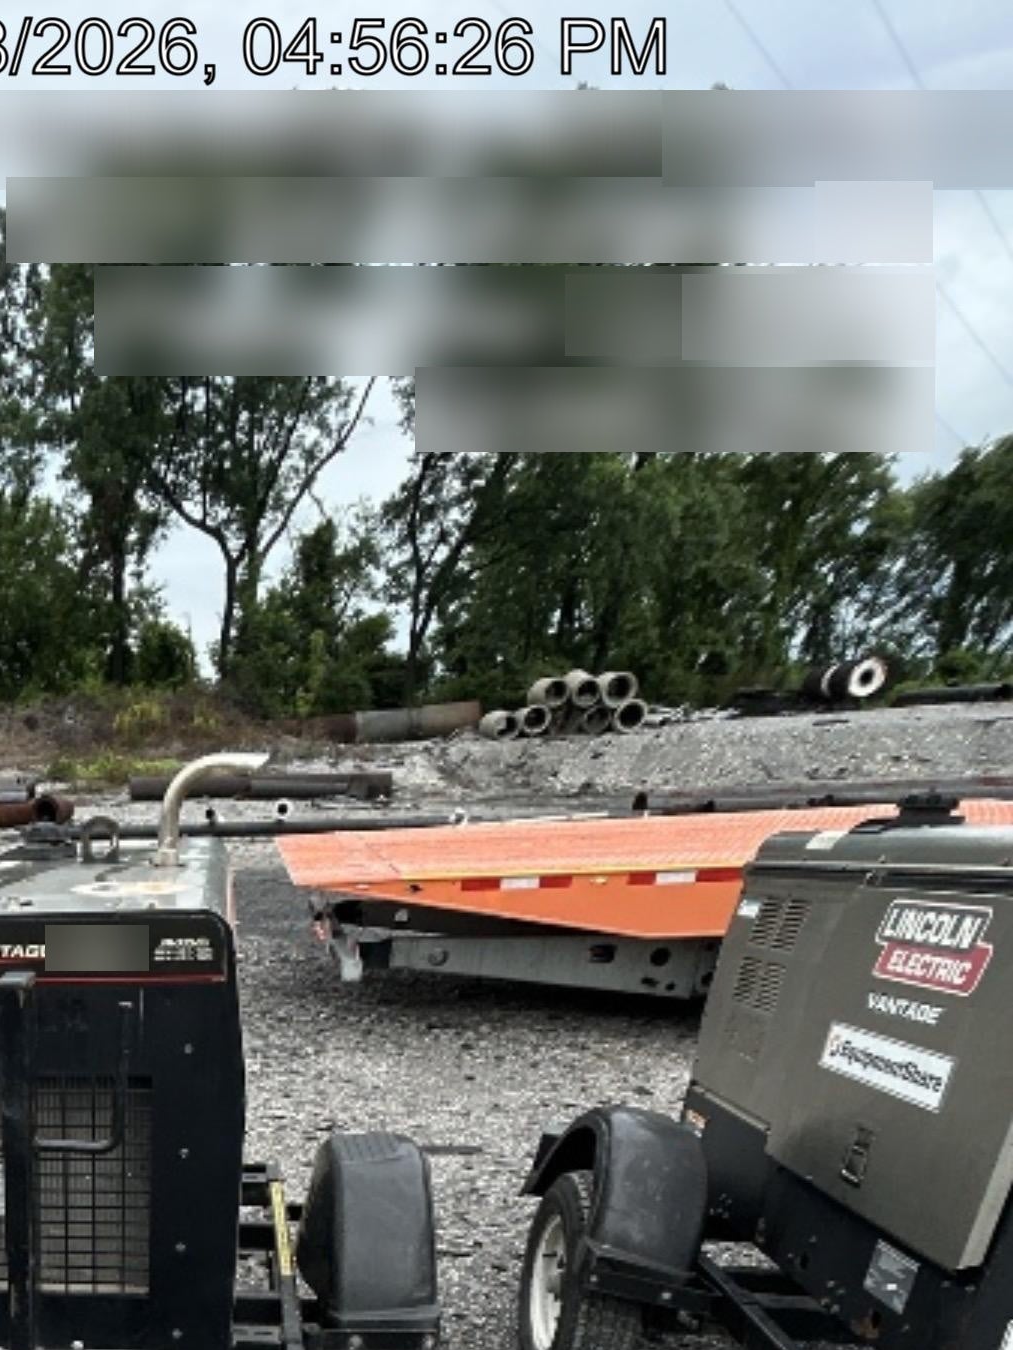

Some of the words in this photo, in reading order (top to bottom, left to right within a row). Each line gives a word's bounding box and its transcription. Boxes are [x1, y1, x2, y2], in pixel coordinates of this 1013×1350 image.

[882, 908, 983, 949] LINCOLN
[886, 948, 972, 985] ELECTRIC
[868, 992, 946, 1026] VANTAGE
